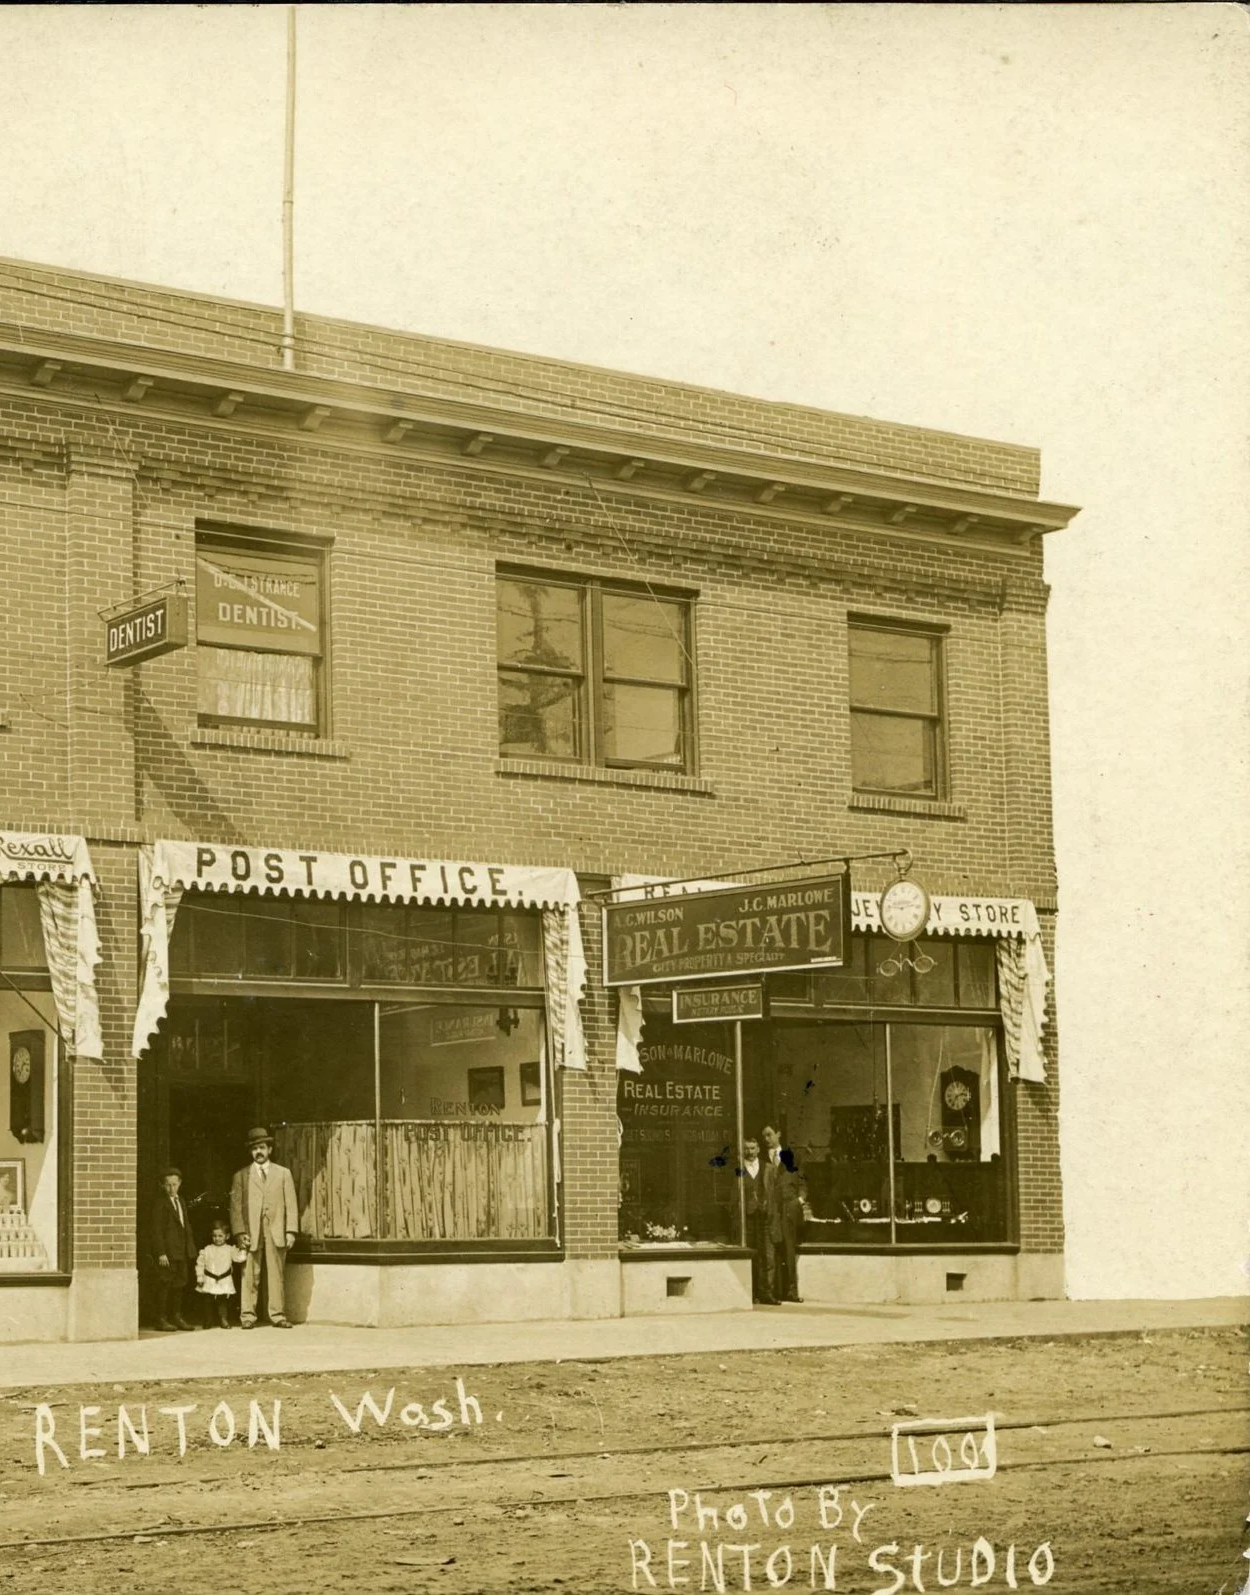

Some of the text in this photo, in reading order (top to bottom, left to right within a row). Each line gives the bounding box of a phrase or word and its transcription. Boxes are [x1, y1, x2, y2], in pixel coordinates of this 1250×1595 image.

[109, 608, 164, 653] DENTIST
[17, 861, 67, 873] STORE
[196, 847, 525, 897] POST OFFICE.
[959, 902, 1021, 924] STORE
[614, 926, 689, 973] REAL
[696, 908, 833, 953] ESTATE
[678, 988, 758, 1011] INSURANCE
[673, 1044, 734, 1075] MARLOWE
[623, 1080, 721, 1100] REAL ESTATE
